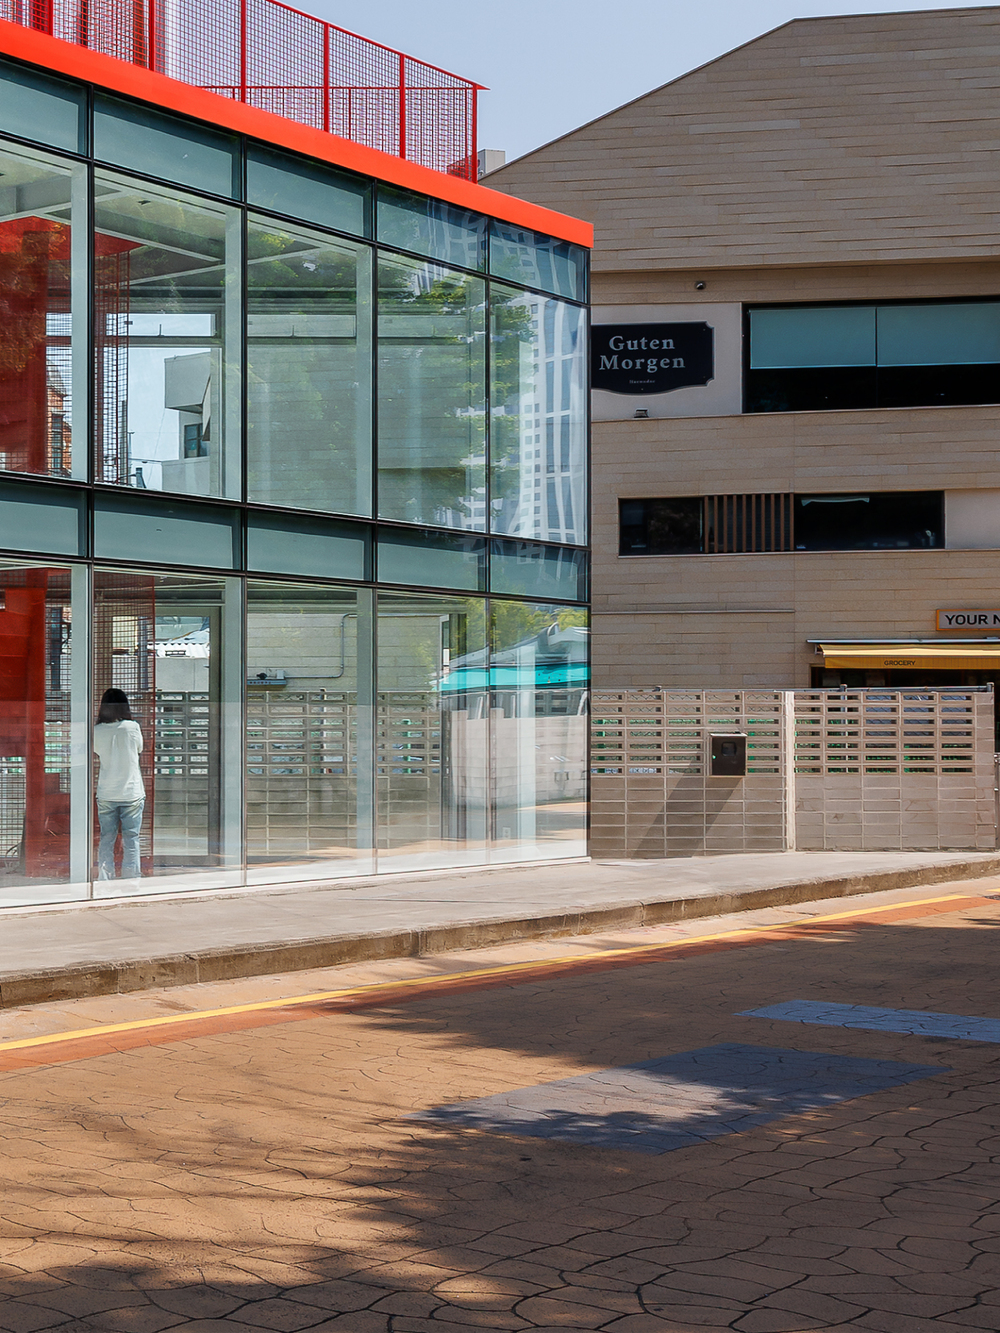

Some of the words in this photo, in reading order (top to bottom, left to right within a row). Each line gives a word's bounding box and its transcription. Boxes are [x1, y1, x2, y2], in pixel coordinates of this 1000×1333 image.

[608, 335, 675, 351] Guten
[599, 354, 685, 373] Morgen
[945, 614, 988, 625] YOUR
